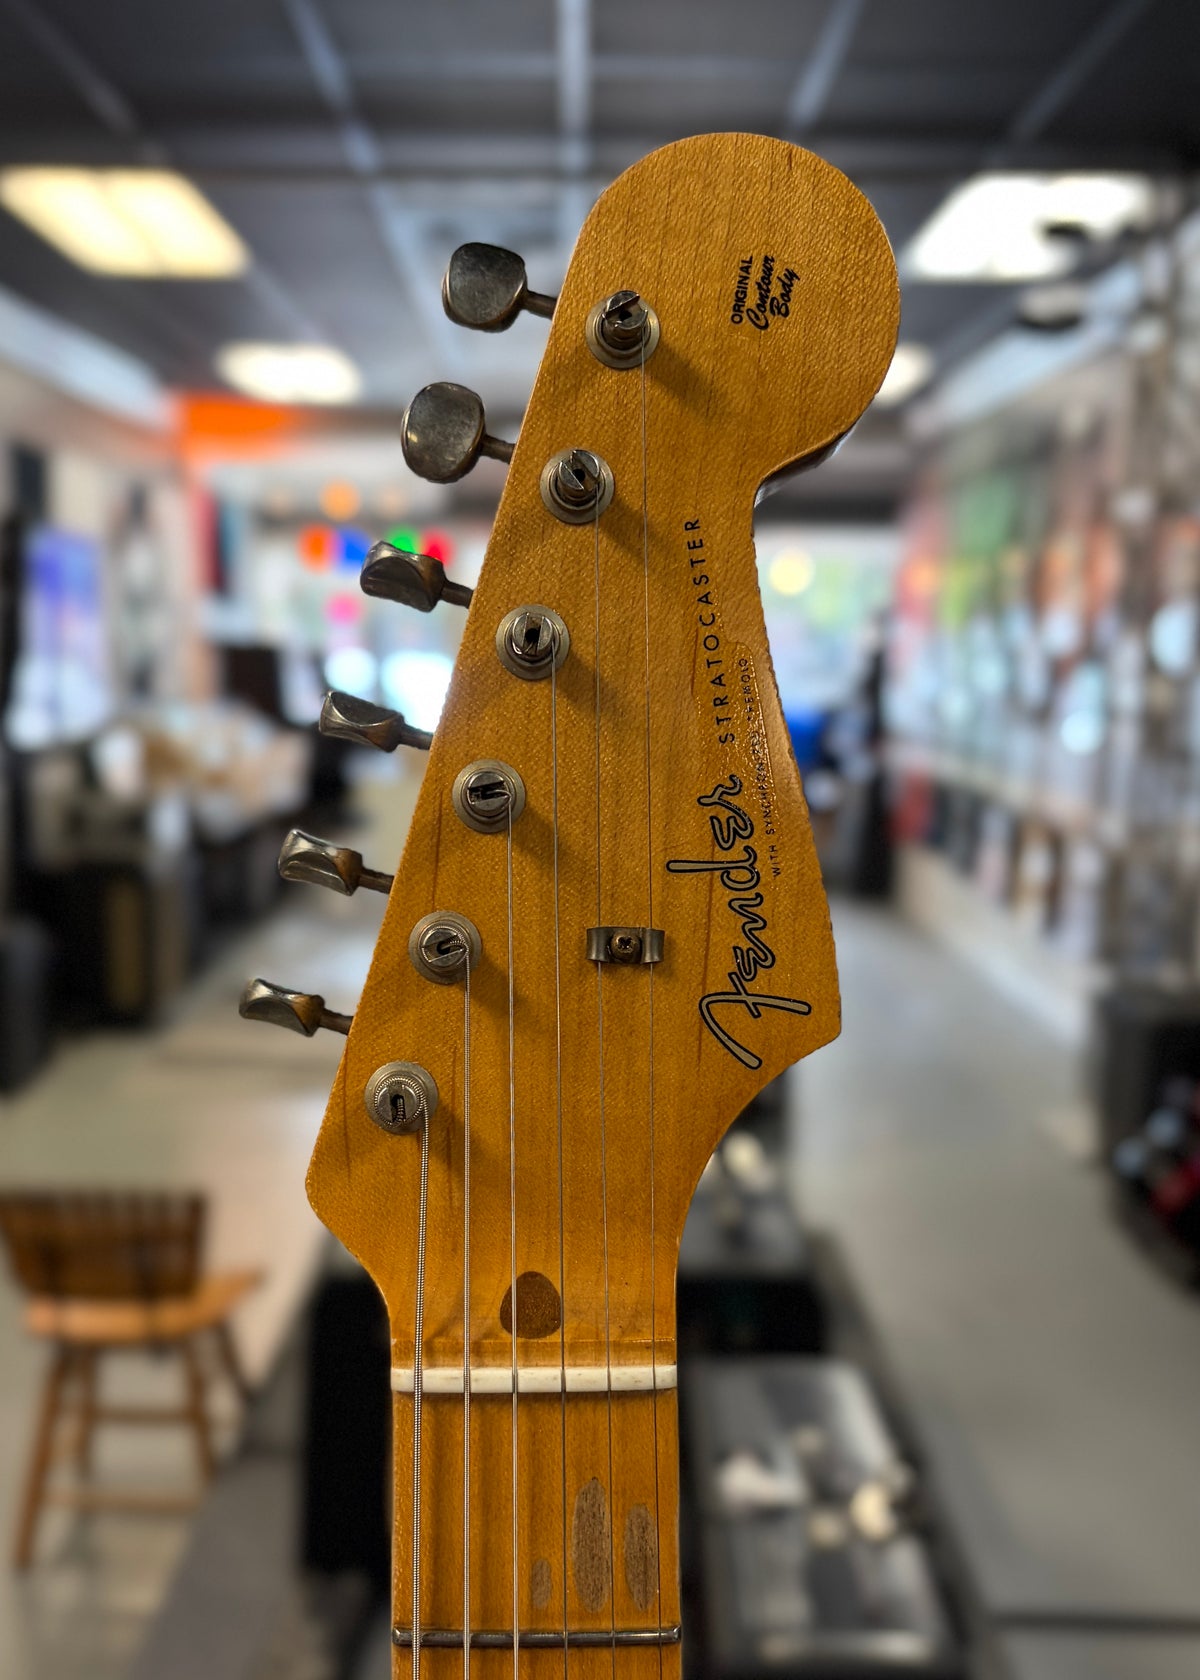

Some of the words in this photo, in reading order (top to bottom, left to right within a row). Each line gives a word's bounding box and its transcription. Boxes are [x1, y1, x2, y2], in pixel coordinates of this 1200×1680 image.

[730, 255, 753, 325] ORIGINAL
[746, 255, 775, 331] Contour
[769, 268, 800, 318] Body
[684, 518, 735, 745] STRATOCASTER
[769, 844, 781, 880] WITH
[666, 774, 812, 1070] Fender
